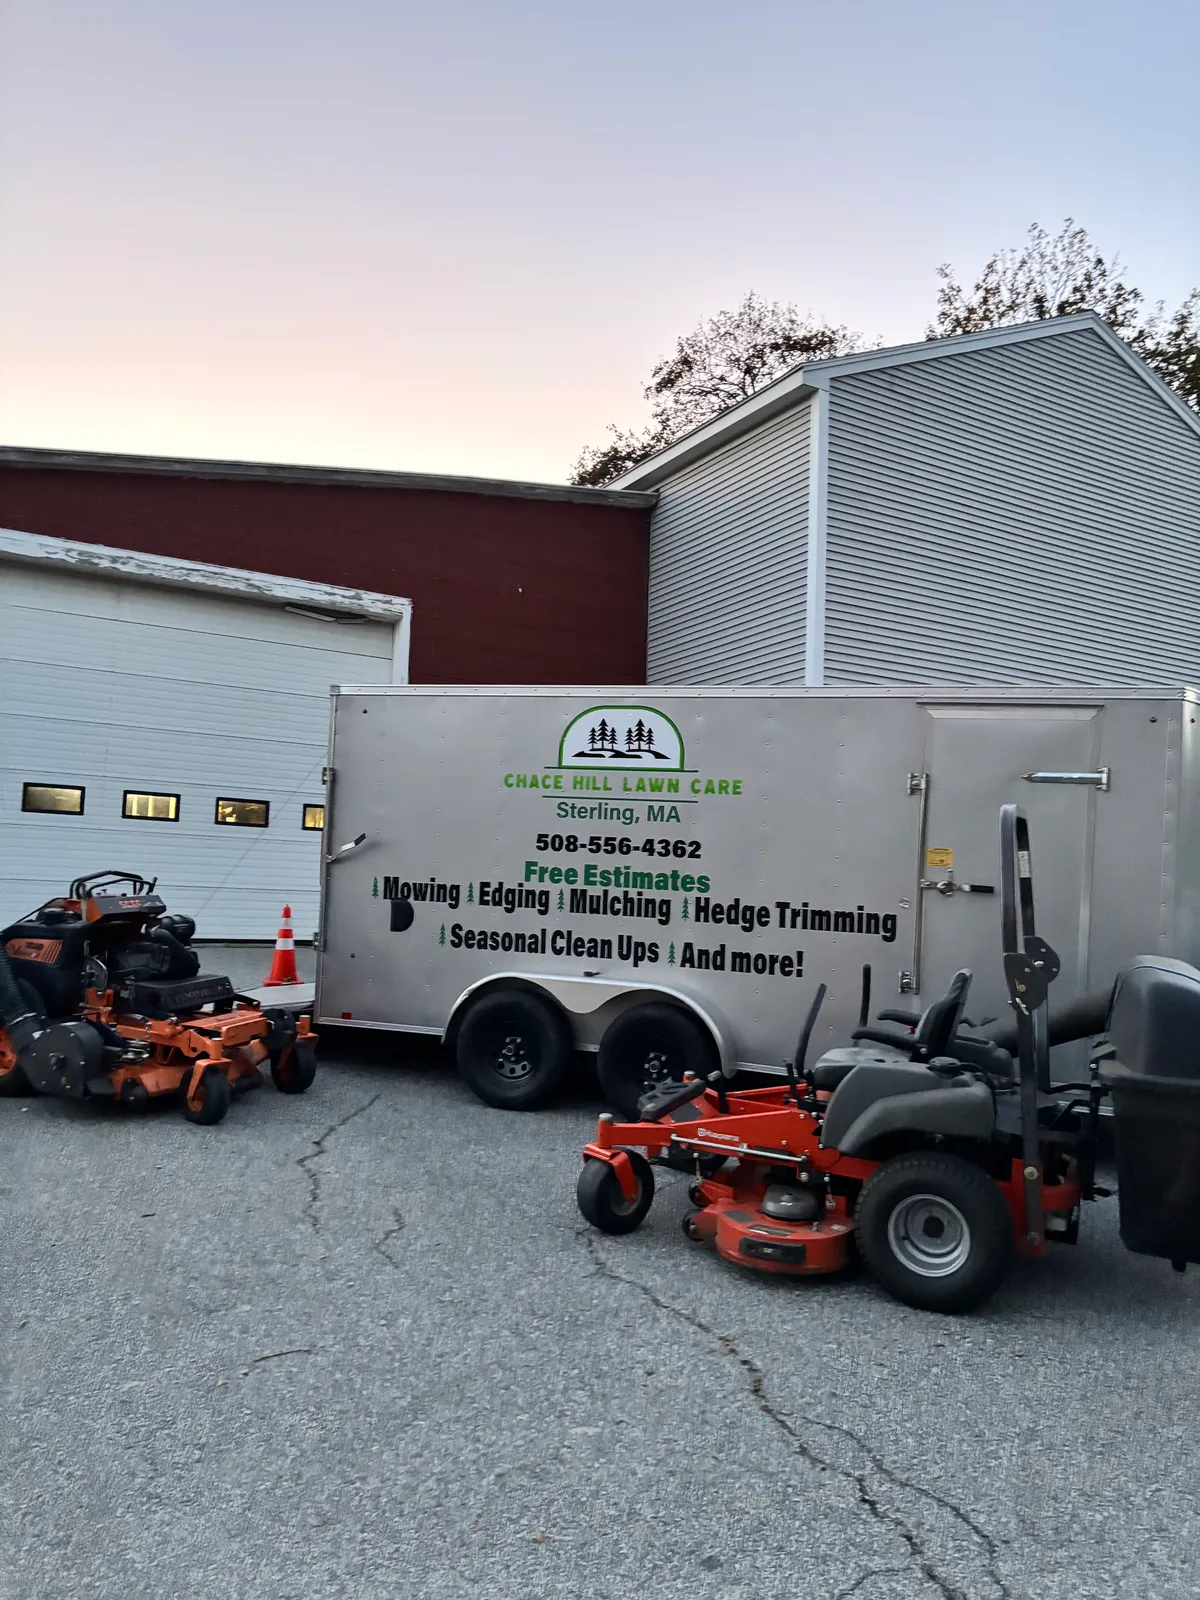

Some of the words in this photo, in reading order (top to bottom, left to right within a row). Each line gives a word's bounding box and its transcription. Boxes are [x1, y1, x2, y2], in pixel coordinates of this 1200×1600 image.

[503, 773, 564, 790] CHACE
[572, 775, 613, 792] HILL
[622, 776, 680, 793] LAWN
[690, 778, 743, 795] CARE
[556, 801, 640, 825] Sterling,
[647, 805, 681, 823] MA
[535, 833, 702, 859] 508-556-4362
[524, 860, 578, 885] Free
[583, 864, 711, 893] Estimates
[383, 876, 460, 909] Mowing
[478, 881, 550, 916] Edging
[569, 888, 672, 925] Mulching
[694, 896, 771, 932] Hedge
[775, 901, 898, 943] Trimming
[450, 923, 547, 954] Seasonal
[551, 929, 613, 959] Clean
[617, 934, 660, 967] Ups
[679, 942, 726, 971] And
[731, 951, 804, 978] more!
